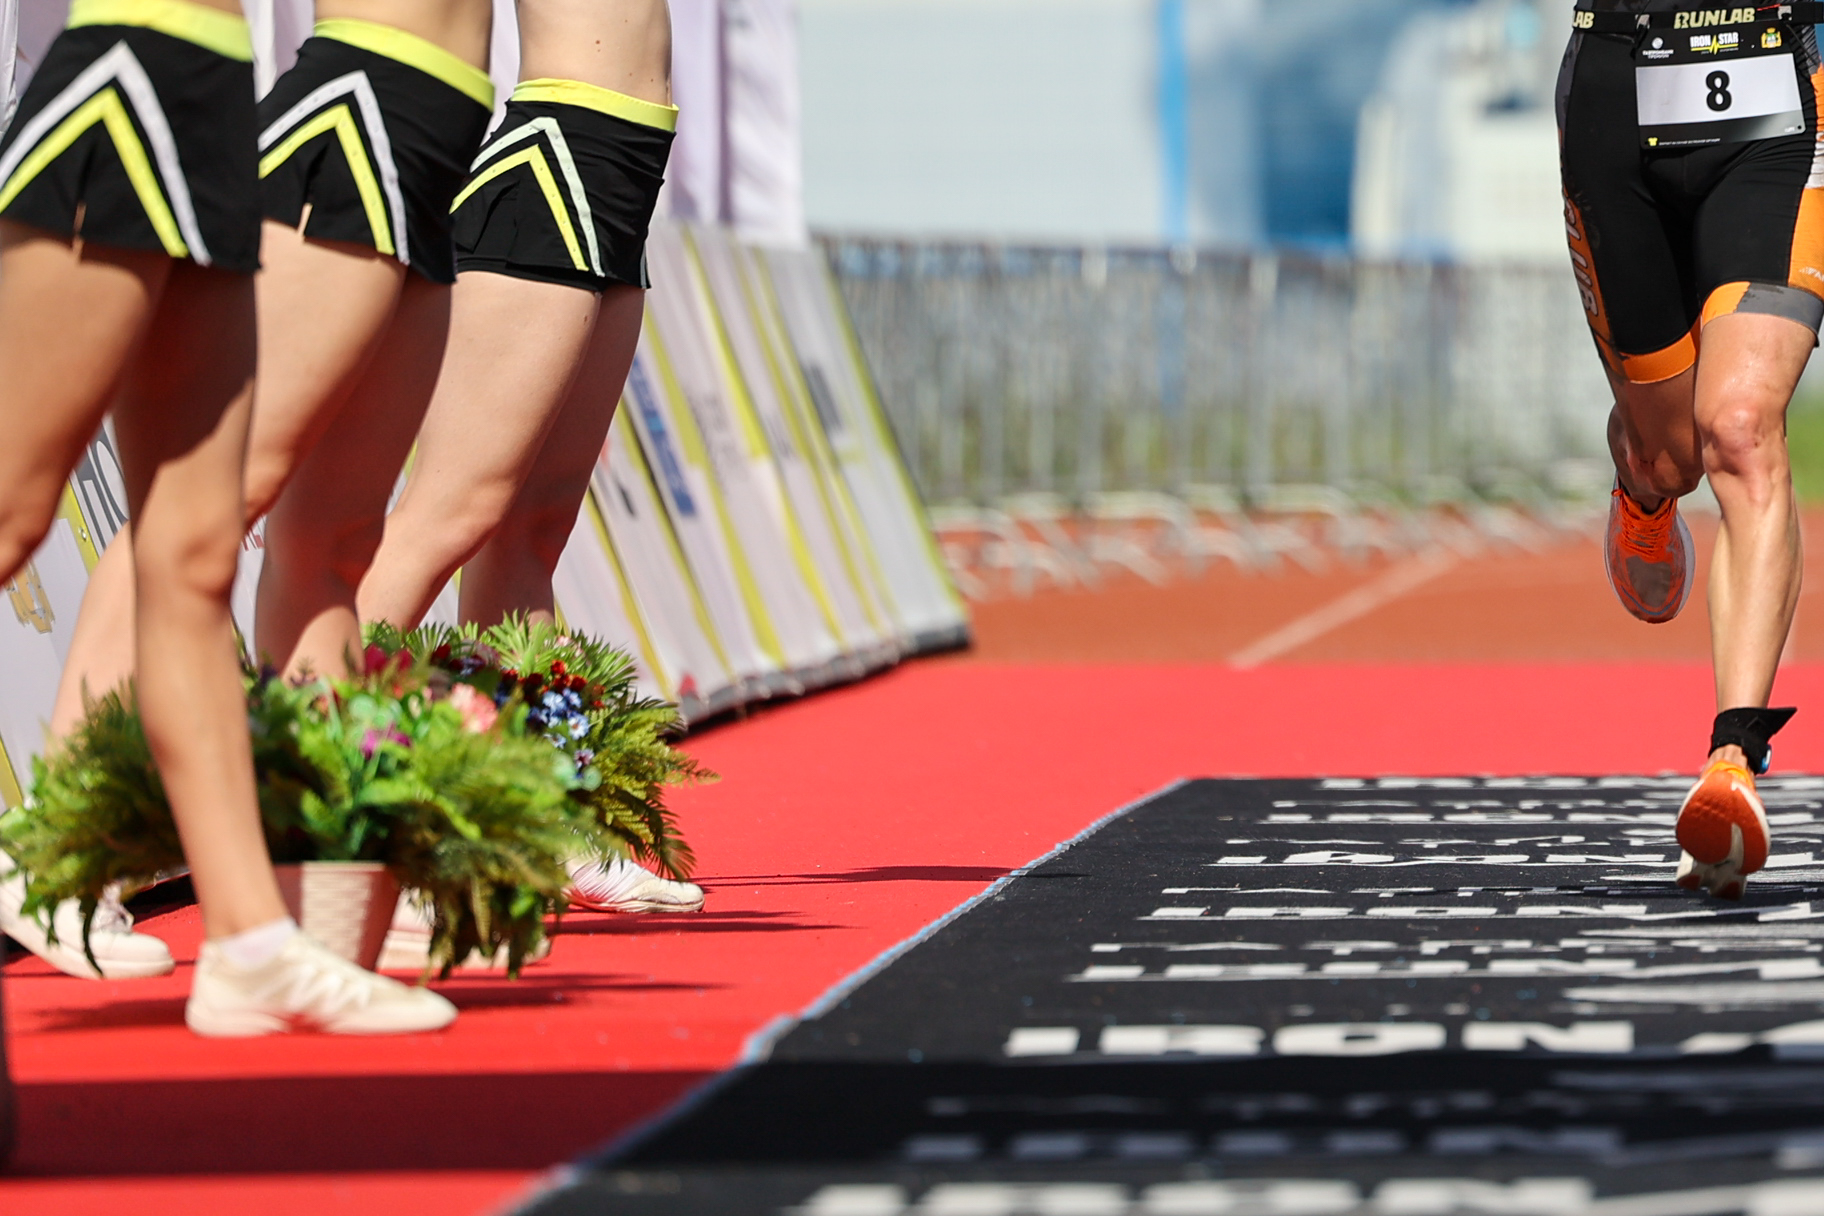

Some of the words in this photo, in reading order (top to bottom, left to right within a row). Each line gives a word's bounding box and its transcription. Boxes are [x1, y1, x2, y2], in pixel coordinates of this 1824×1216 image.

[1673, 7, 1756, 29] RUNLAB
[1690, 34, 1711, 48] IRON
[1718, 31, 1739, 45] STAR
[1705, 70, 1732, 112] 8
[1005, 1020, 1634, 1058] IRON
